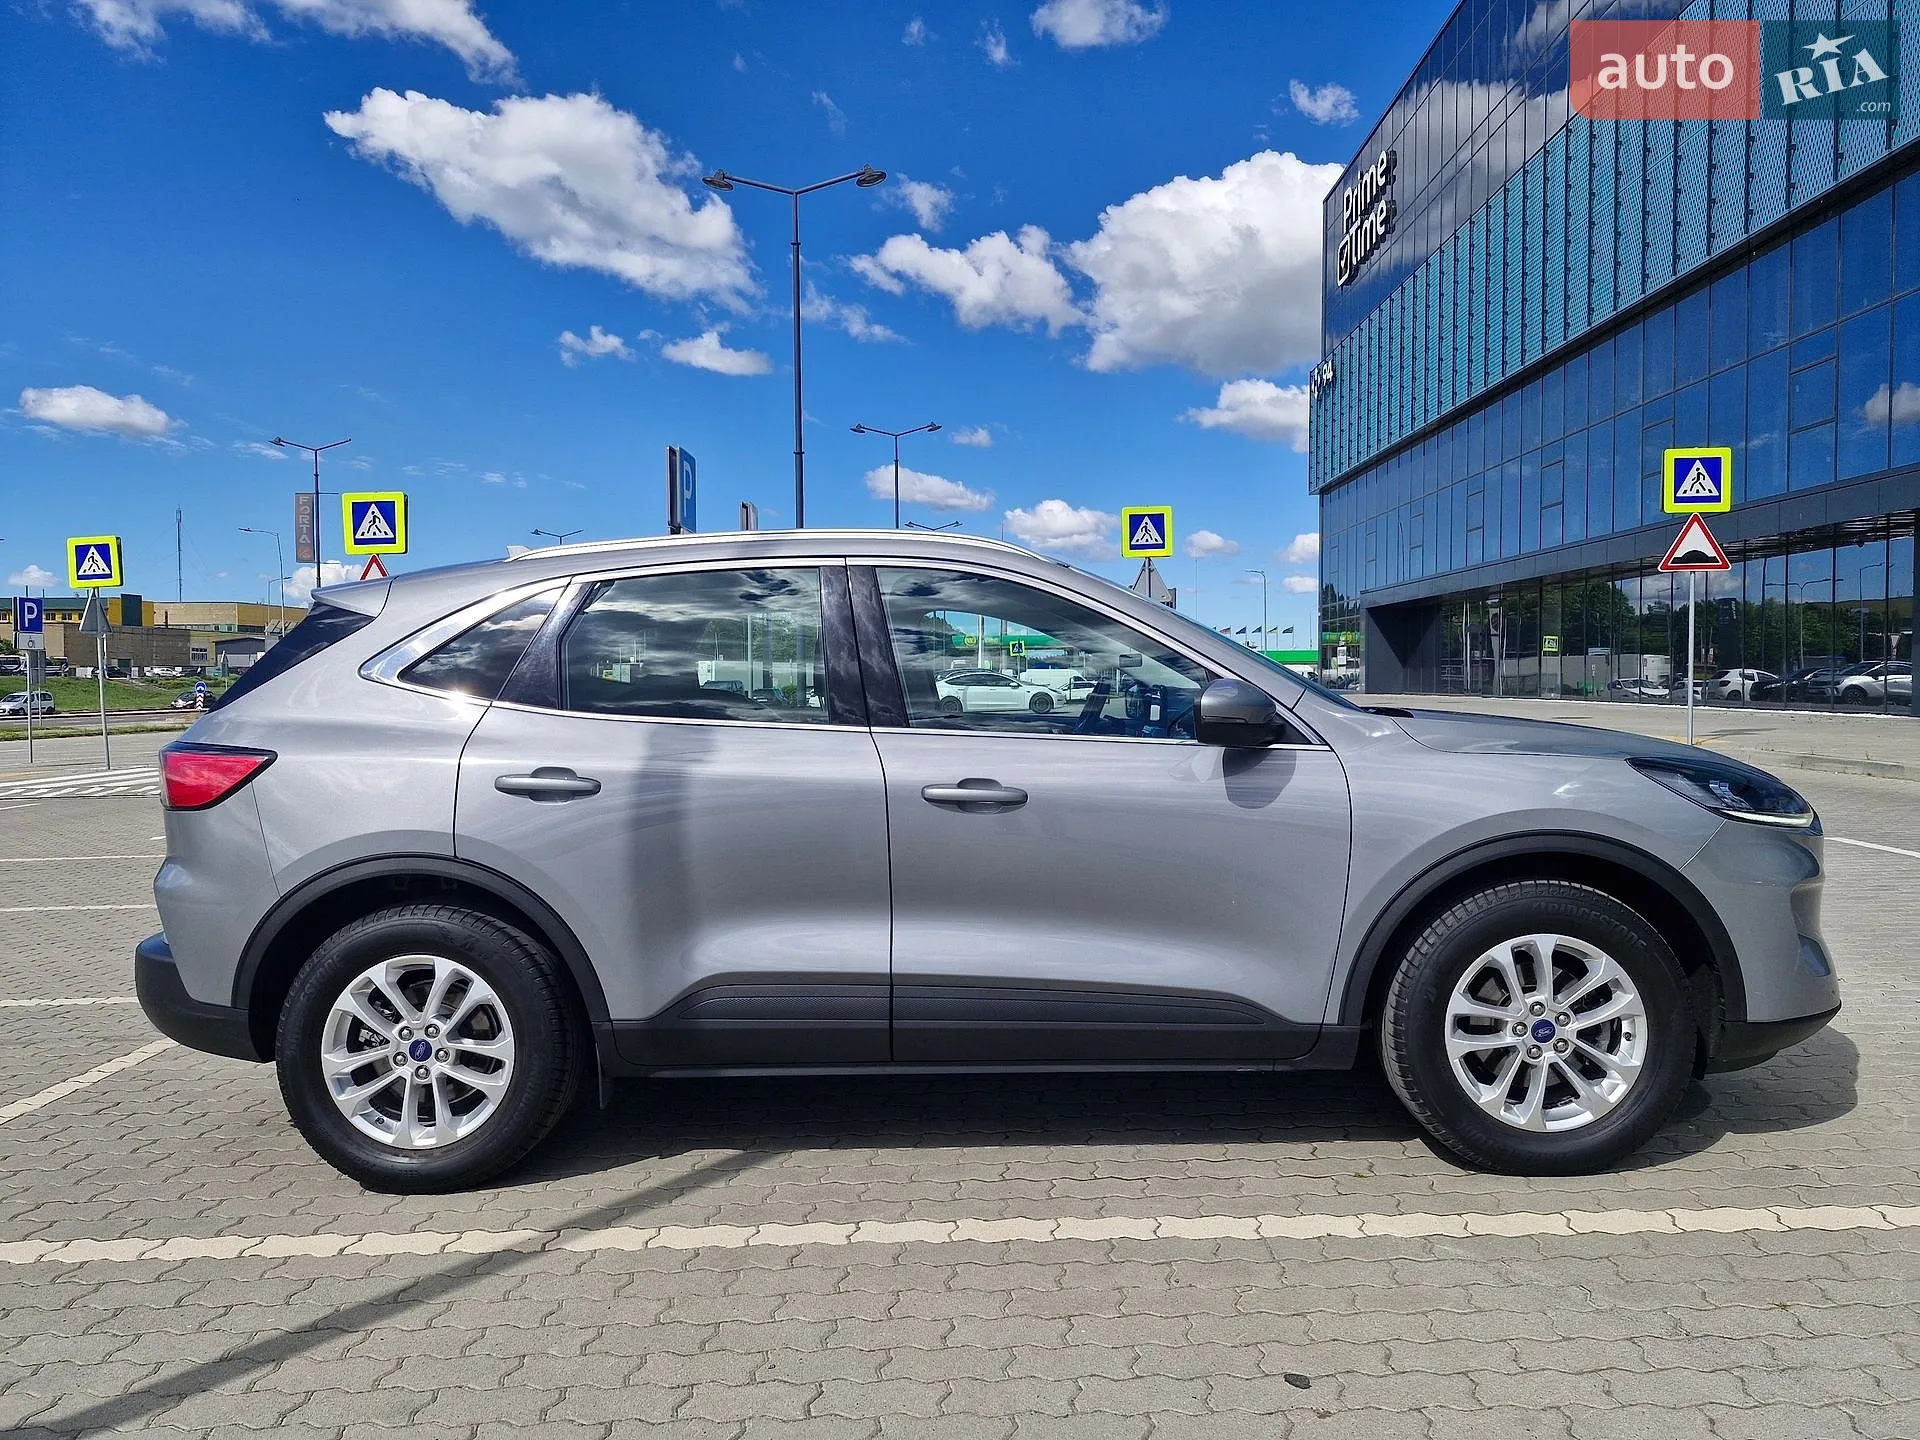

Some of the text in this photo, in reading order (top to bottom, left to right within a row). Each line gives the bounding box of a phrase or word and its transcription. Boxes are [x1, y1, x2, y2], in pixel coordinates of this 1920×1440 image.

[1343, 150, 1387, 234] Prime
[683, 460, 693, 518] P
[299, 496, 312, 544] FORTA
[24, 601, 38, 628] P
